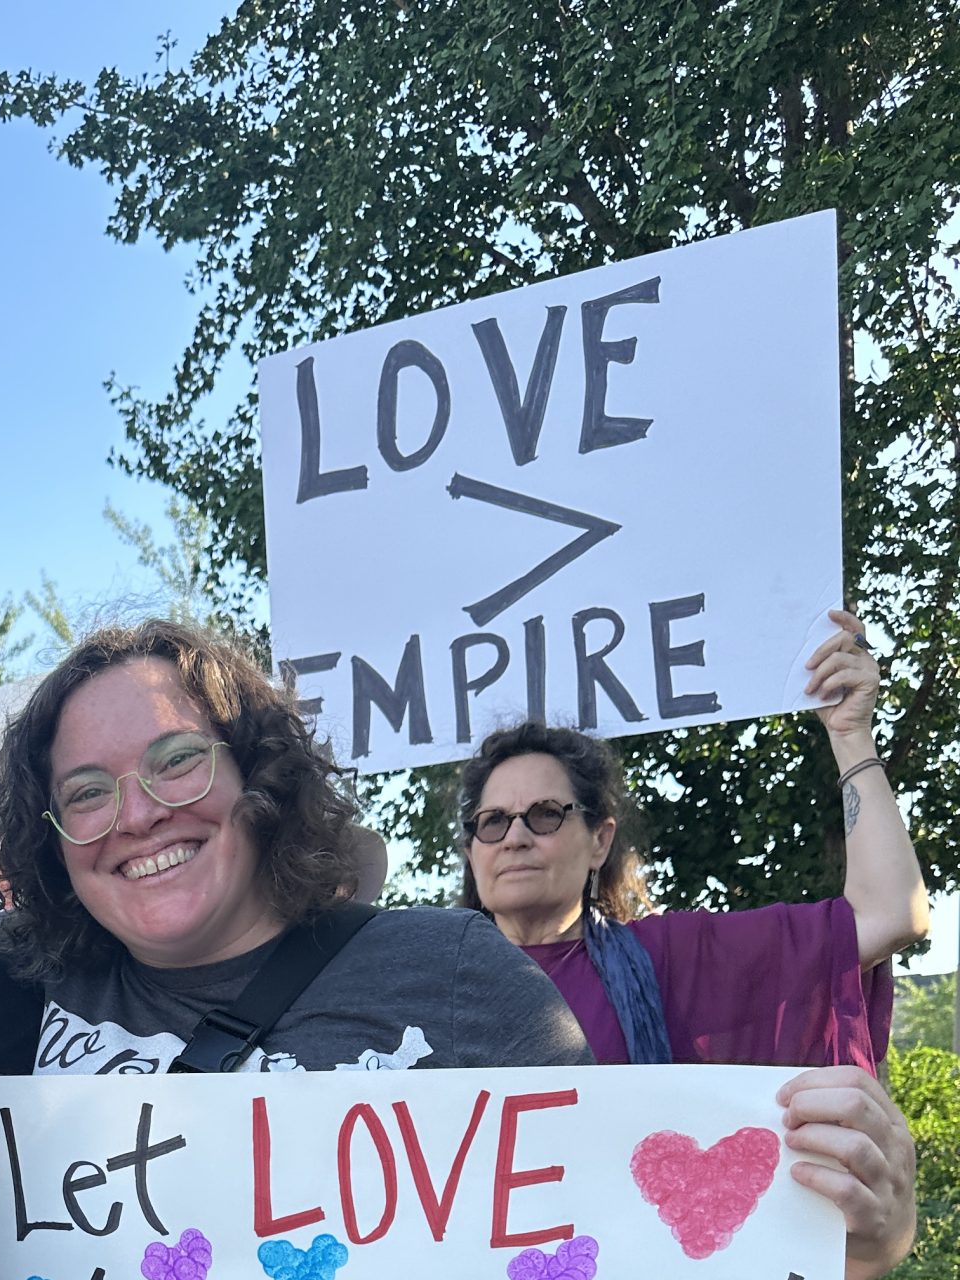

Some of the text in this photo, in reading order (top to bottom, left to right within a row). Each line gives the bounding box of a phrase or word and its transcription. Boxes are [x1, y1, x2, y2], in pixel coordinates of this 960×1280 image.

[295, 275, 662, 504] LOVE
[277, 592, 722, 760] EMPIRE
[0, 1089, 578, 1248] Let LOVE
